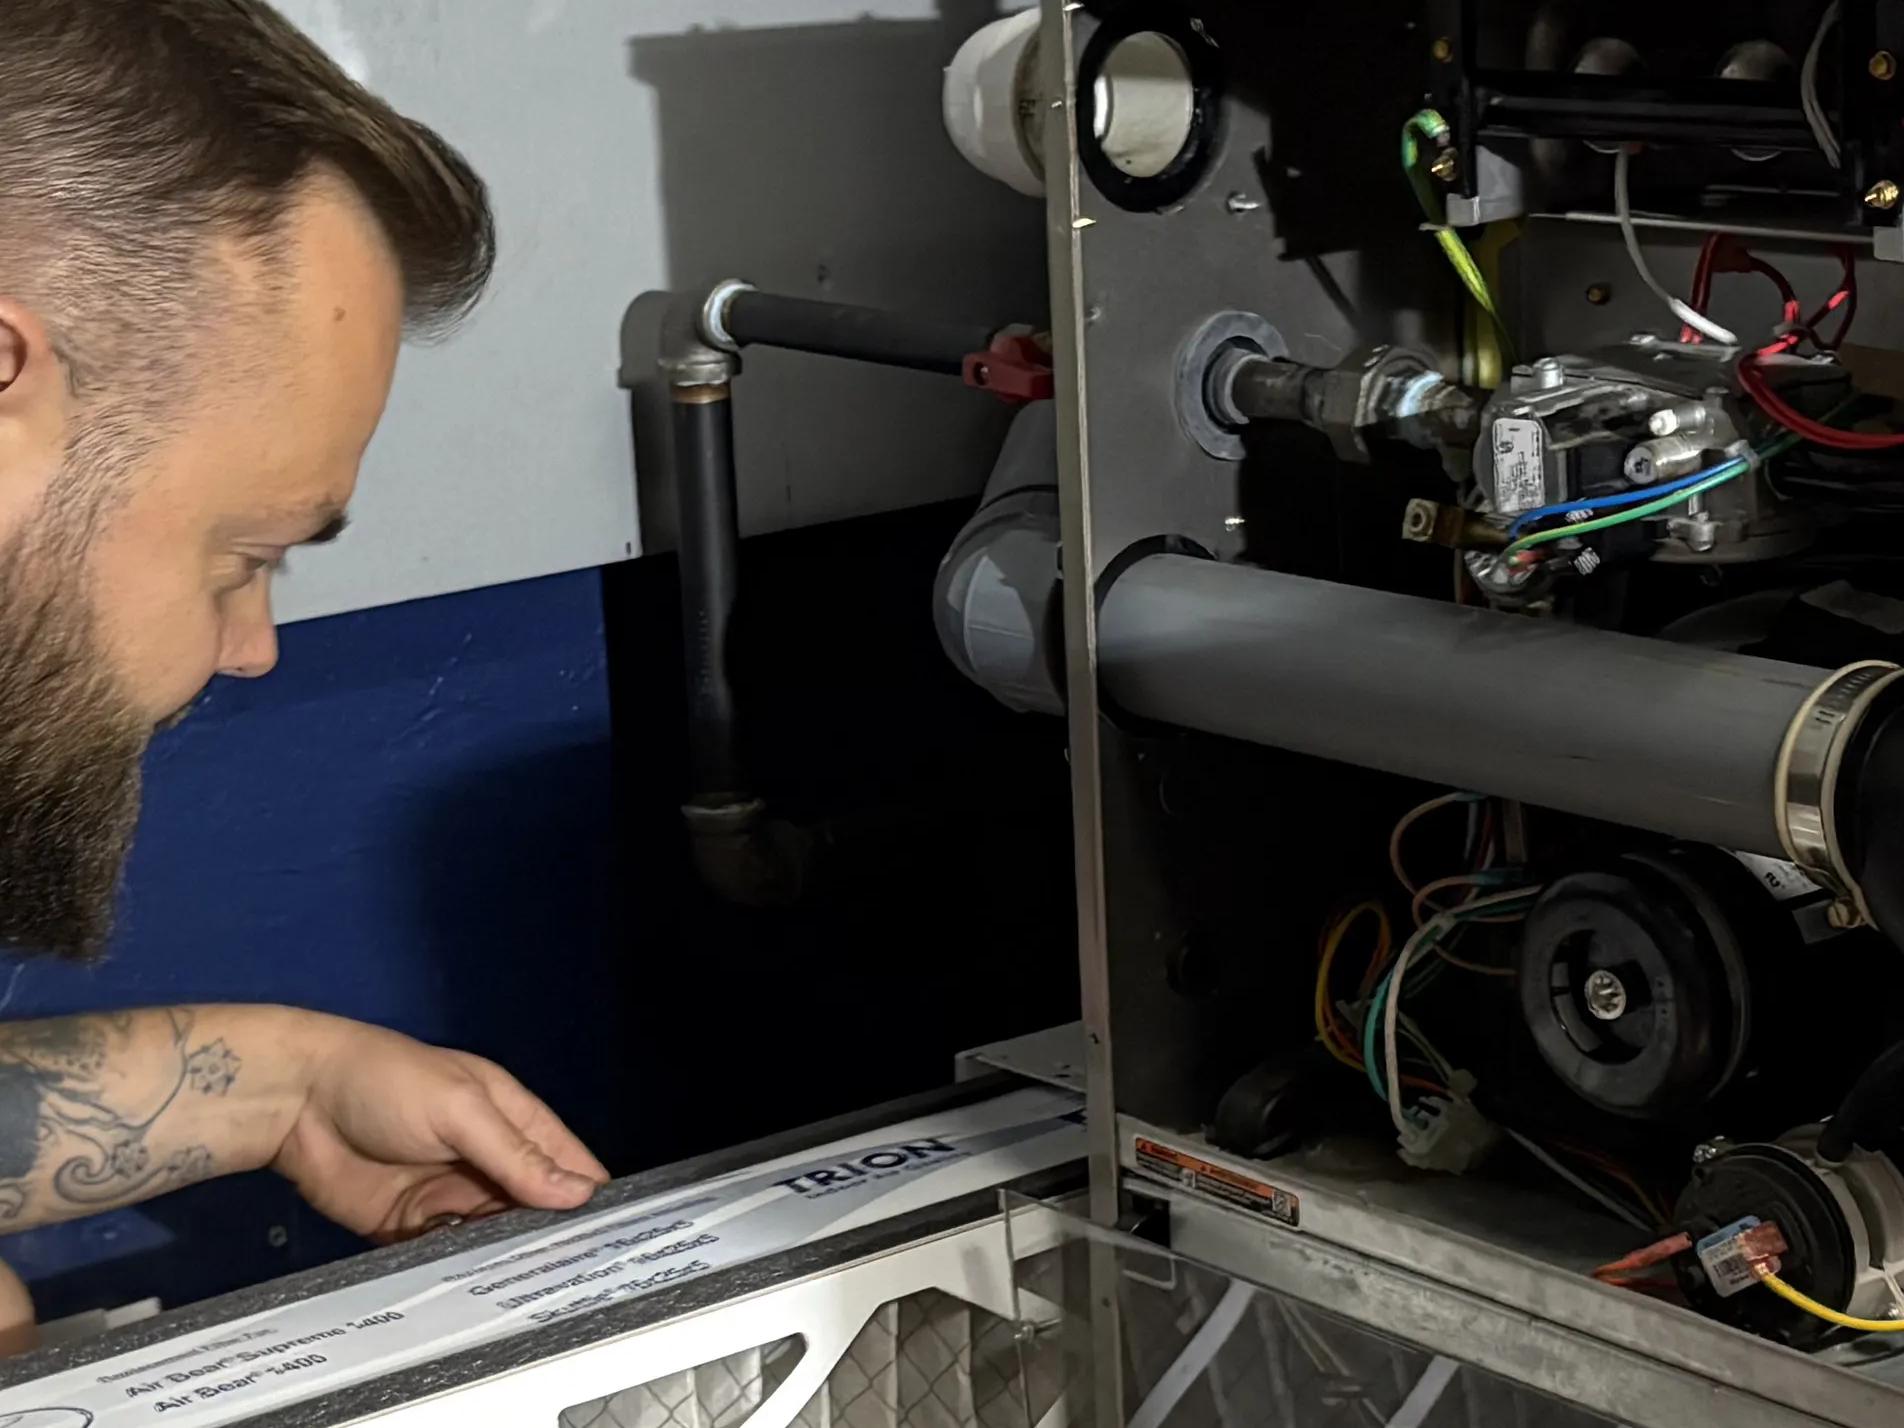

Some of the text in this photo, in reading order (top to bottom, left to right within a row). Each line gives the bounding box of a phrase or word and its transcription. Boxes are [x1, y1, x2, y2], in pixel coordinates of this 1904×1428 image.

[772, 1137, 955, 1194] TRION
[126, 1378, 163, 1399] Air
[236, 1327, 346, 1362] Supreme
[154, 1395, 193, 1413] Air
